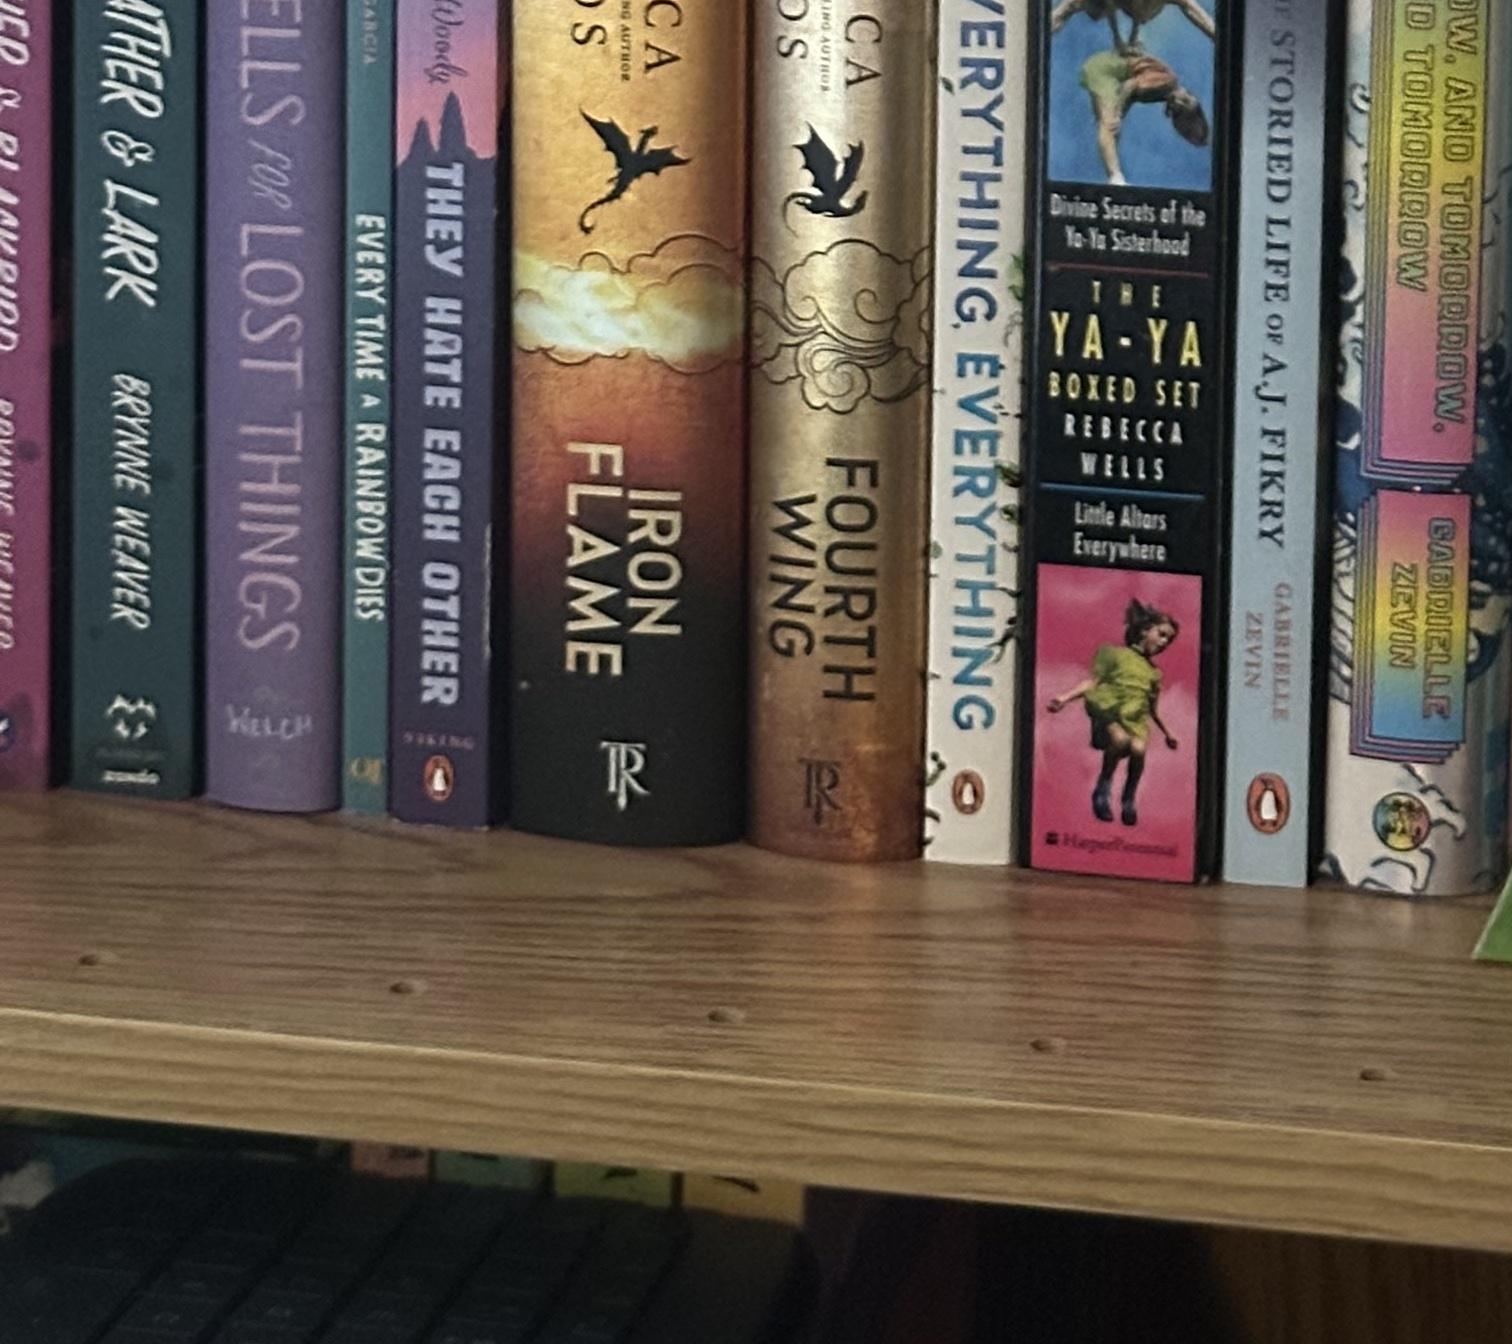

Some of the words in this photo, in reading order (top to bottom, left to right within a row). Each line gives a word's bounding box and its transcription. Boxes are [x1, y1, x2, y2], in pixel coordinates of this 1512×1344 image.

[101, 130, 157, 167] &
[246, 138, 294, 210] FOR
[101, 179, 160, 309] LARK
[423, 161, 465, 278] THEY
[239, 223, 305, 390] LOST
[422, 295, 465, 410] HATE
[110, 371, 152, 497] BRYNNE
[1047, 370, 1137, 405] BOXED
[1154, 379, 1201, 410] SET
[1063, 412, 1184, 445] REBECCA
[421, 425, 463, 543] EACH
[1074, 500, 1116, 526] Little
[1119, 504, 1168, 532] Altars
[1080, 451, 1165, 481] WELLS
[110, 505, 152, 631] WEAVER
[236, 410, 304, 652] THINGS
[564, 440, 625, 677] FLAME
[625, 487, 684, 636] IRON
[767, 493, 816, 659] WING
[821, 456, 880, 703] FOURTH
[950, 351, 1001, 733] EVERYTHING
[1073, 531, 1168, 563] Everywhere
[419, 560, 462, 707] OTHER
